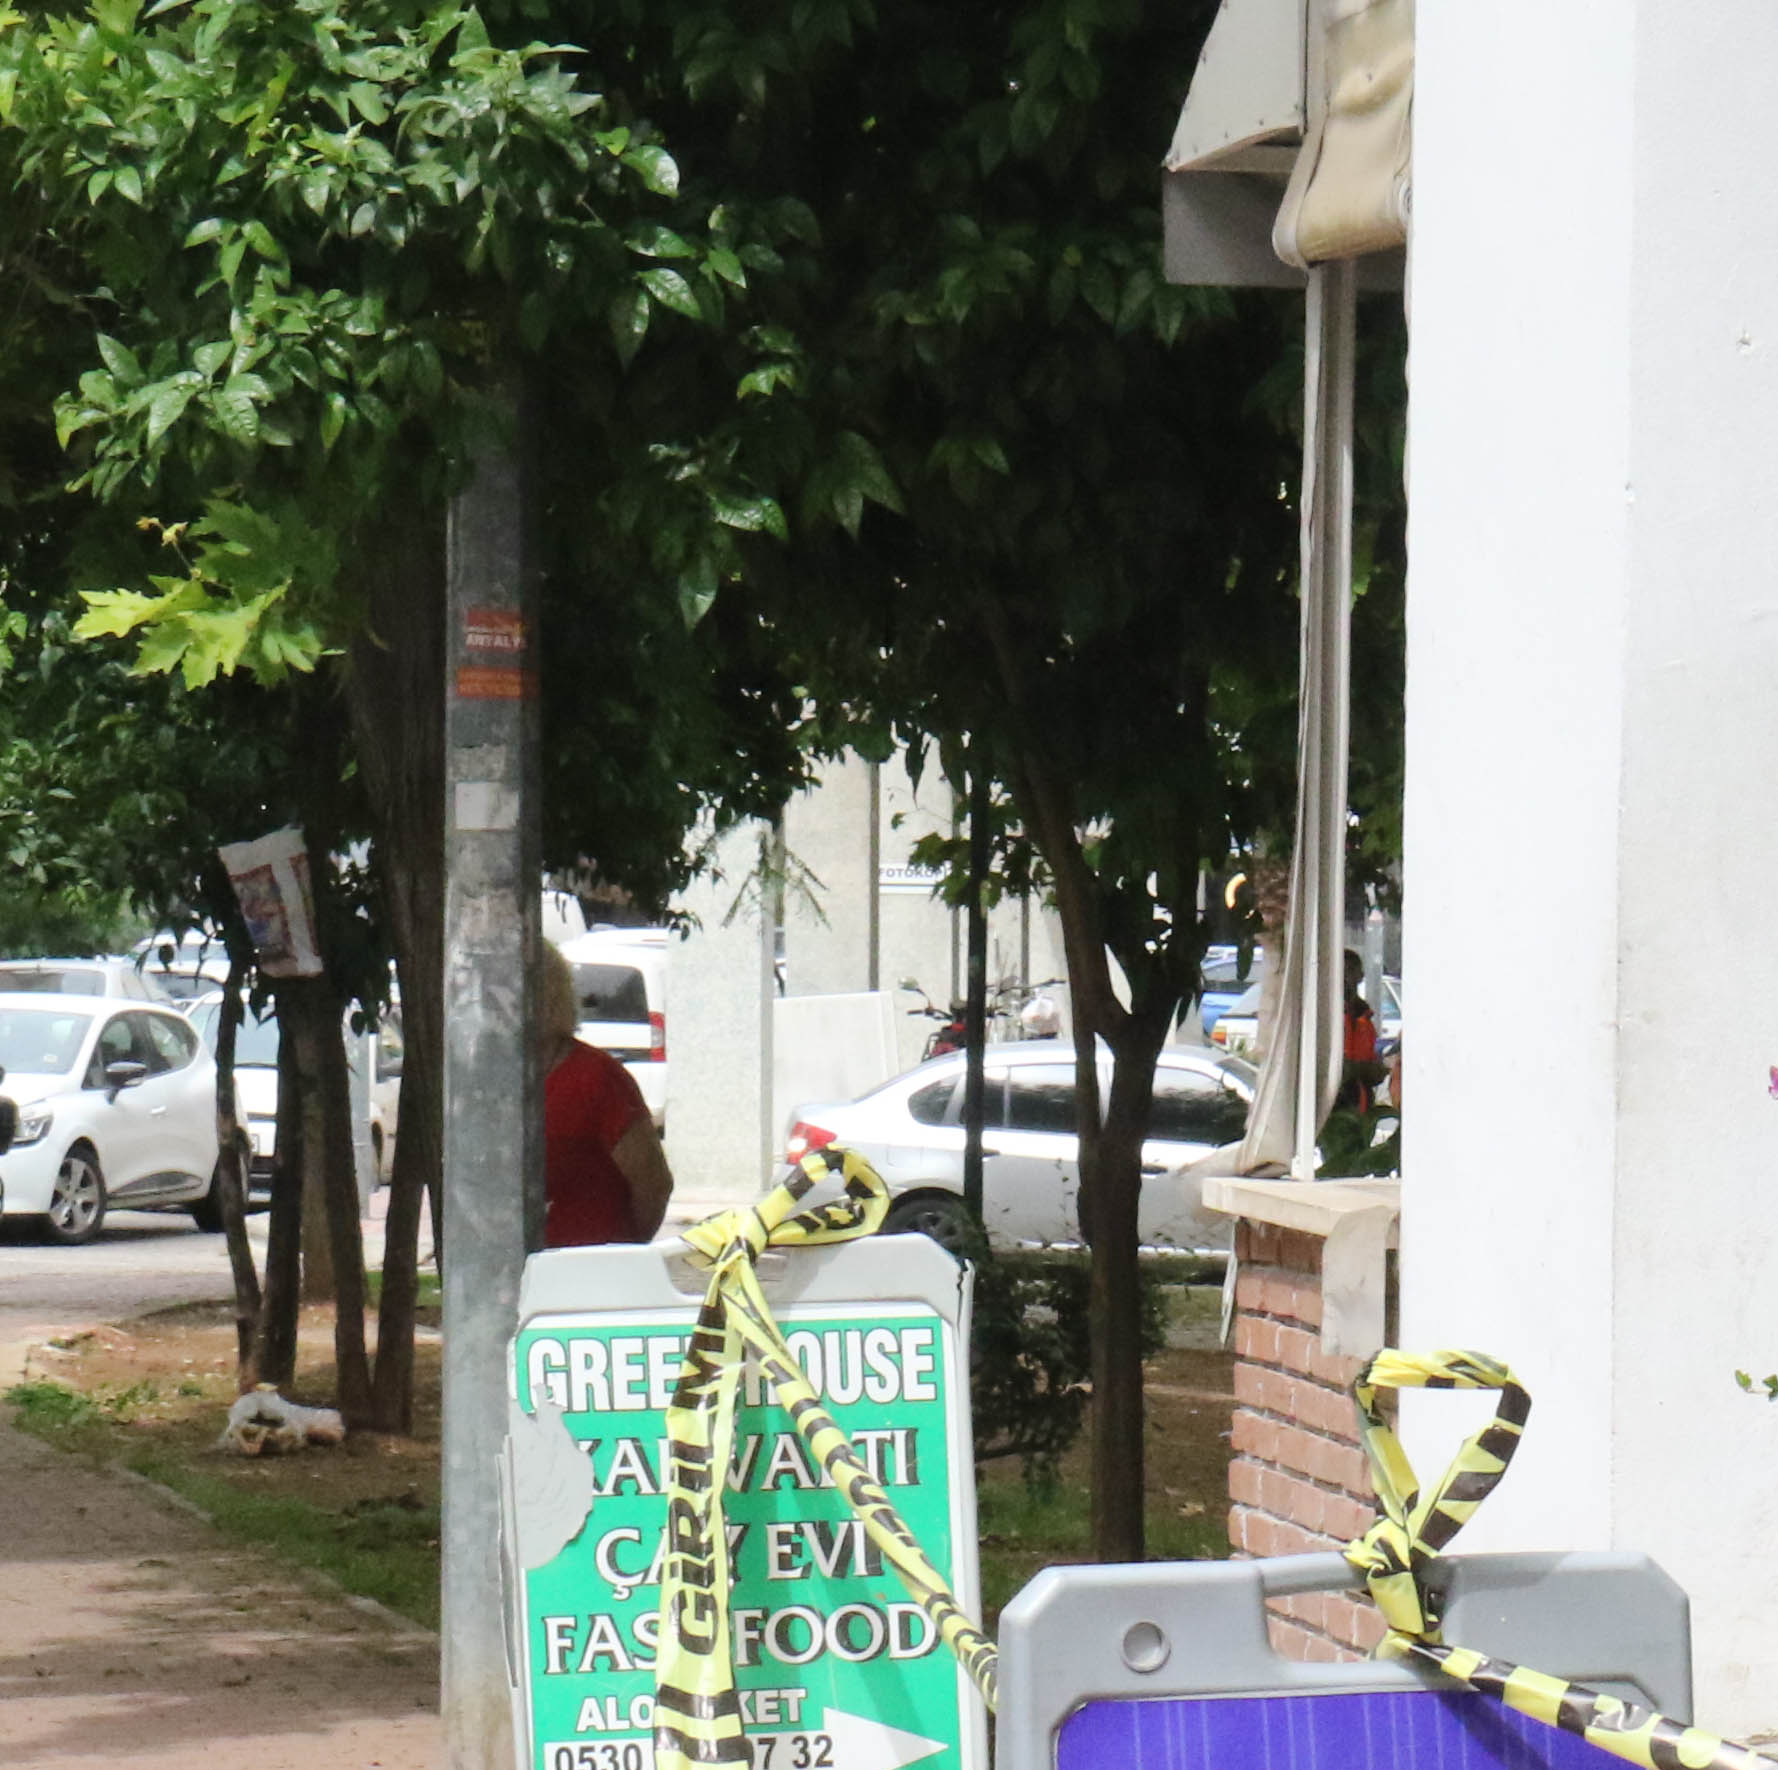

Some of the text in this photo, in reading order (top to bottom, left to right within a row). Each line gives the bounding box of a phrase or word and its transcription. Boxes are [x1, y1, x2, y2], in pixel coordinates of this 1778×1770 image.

[527, 1335, 692, 1412] GREE
[543, 1601, 942, 1675] FAS FOOD
[575, 1694, 657, 1732] ALO
[790, 1734, 834, 1769] 32
